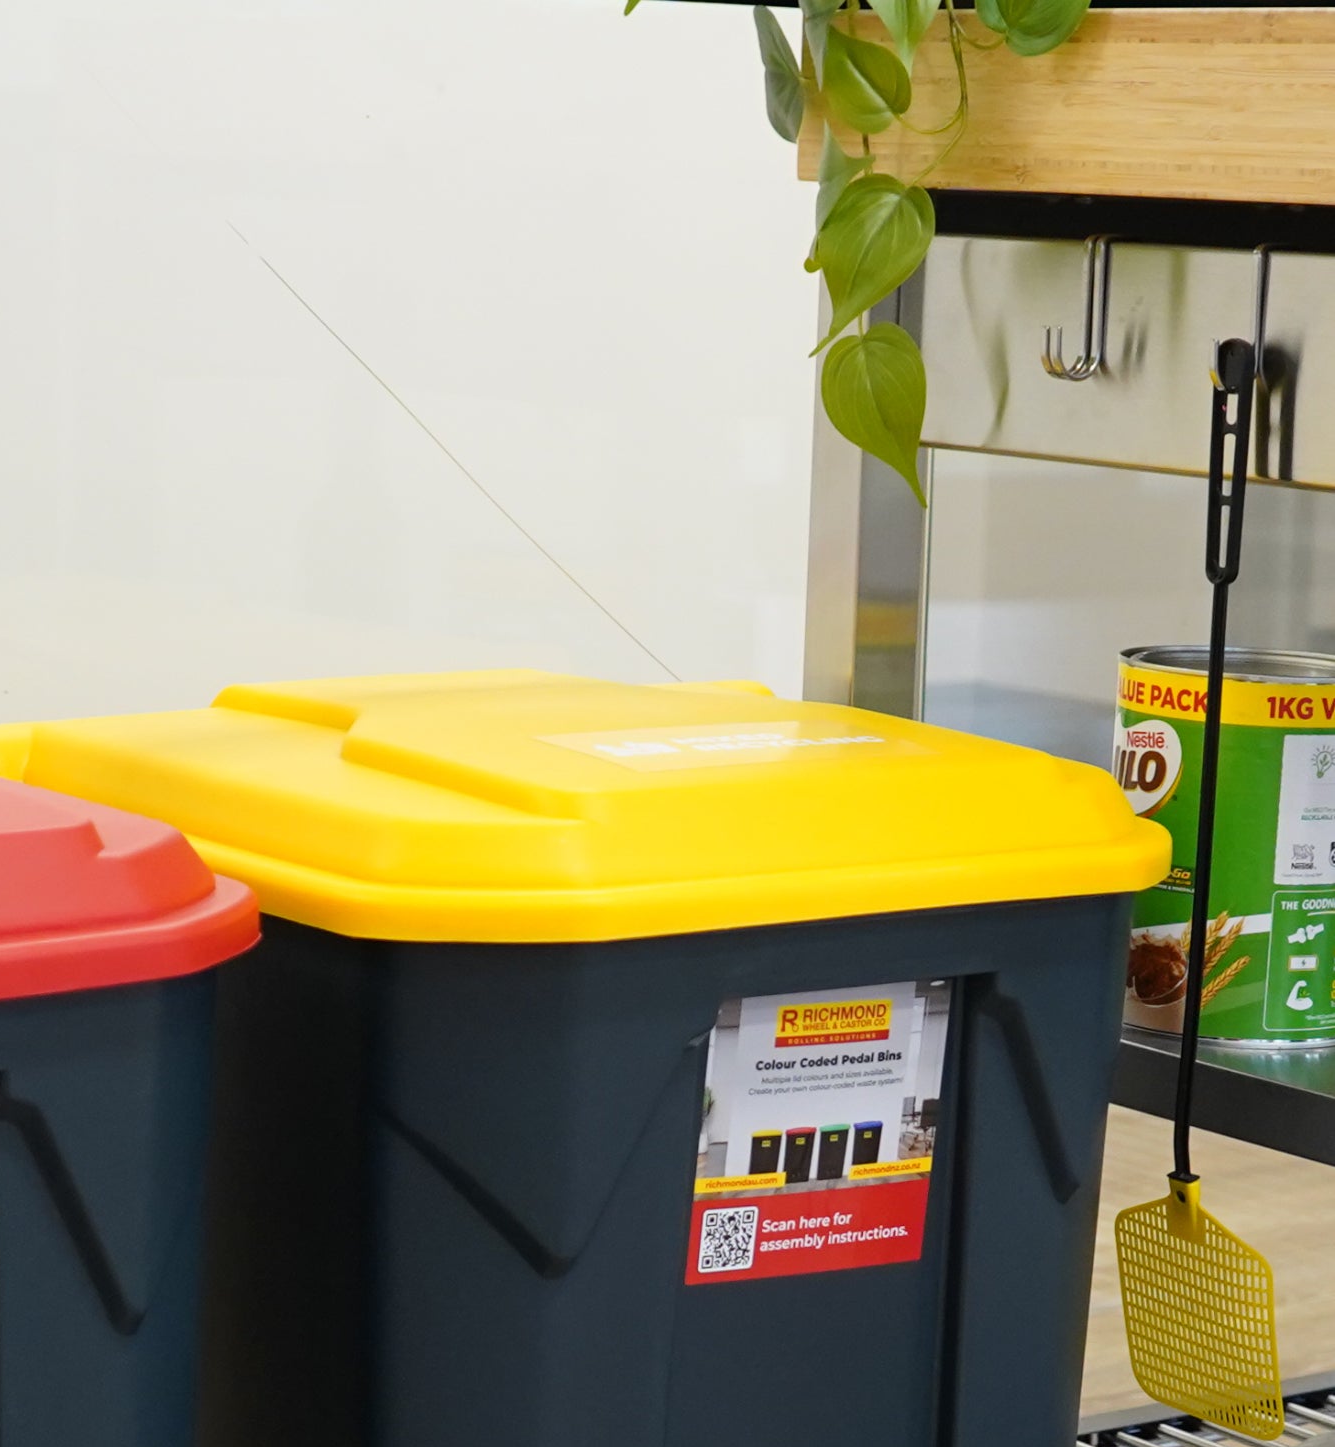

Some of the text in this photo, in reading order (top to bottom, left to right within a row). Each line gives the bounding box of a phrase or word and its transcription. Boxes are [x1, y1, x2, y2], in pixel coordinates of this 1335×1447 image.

[1150, 685, 1208, 714] PACK
[1267, 697, 1313, 720] 1KG
[1127, 731, 1165, 748] Nestlé
[1281, 901, 1299, 910] THE
[803, 1004, 887, 1022] RICHMOND
[803, 1022, 830, 1032] WHEEL
[840, 1020, 873, 1029] CASTOR
[874, 1018, 886, 1026] CO
[788, 1033, 877, 1045] ROLLING SOLUTIONS
[755, 1050, 902, 1071] Colour Coded Pedal Bins
[761, 1076, 791, 1085] Multiple
[803, 1073, 829, 1082] colours
[831, 1072, 844, 1080] and
[845, 1071, 861, 1079] sizes
[748, 1087, 772, 1096] Create
[774, 1086, 791, 1096] your
[792, 1085, 808, 1093] own
[809, 1081, 855, 1092] colour-coded
[856, 1079, 876, 1087] waste
[853, 1162, 921, 1177] richmondnz.co.nz
[705, 1176, 778, 1189] richmondau.com
[761, 1211, 852, 1233] Scan here for
[760, 1223, 908, 1252] assembly instructions.
